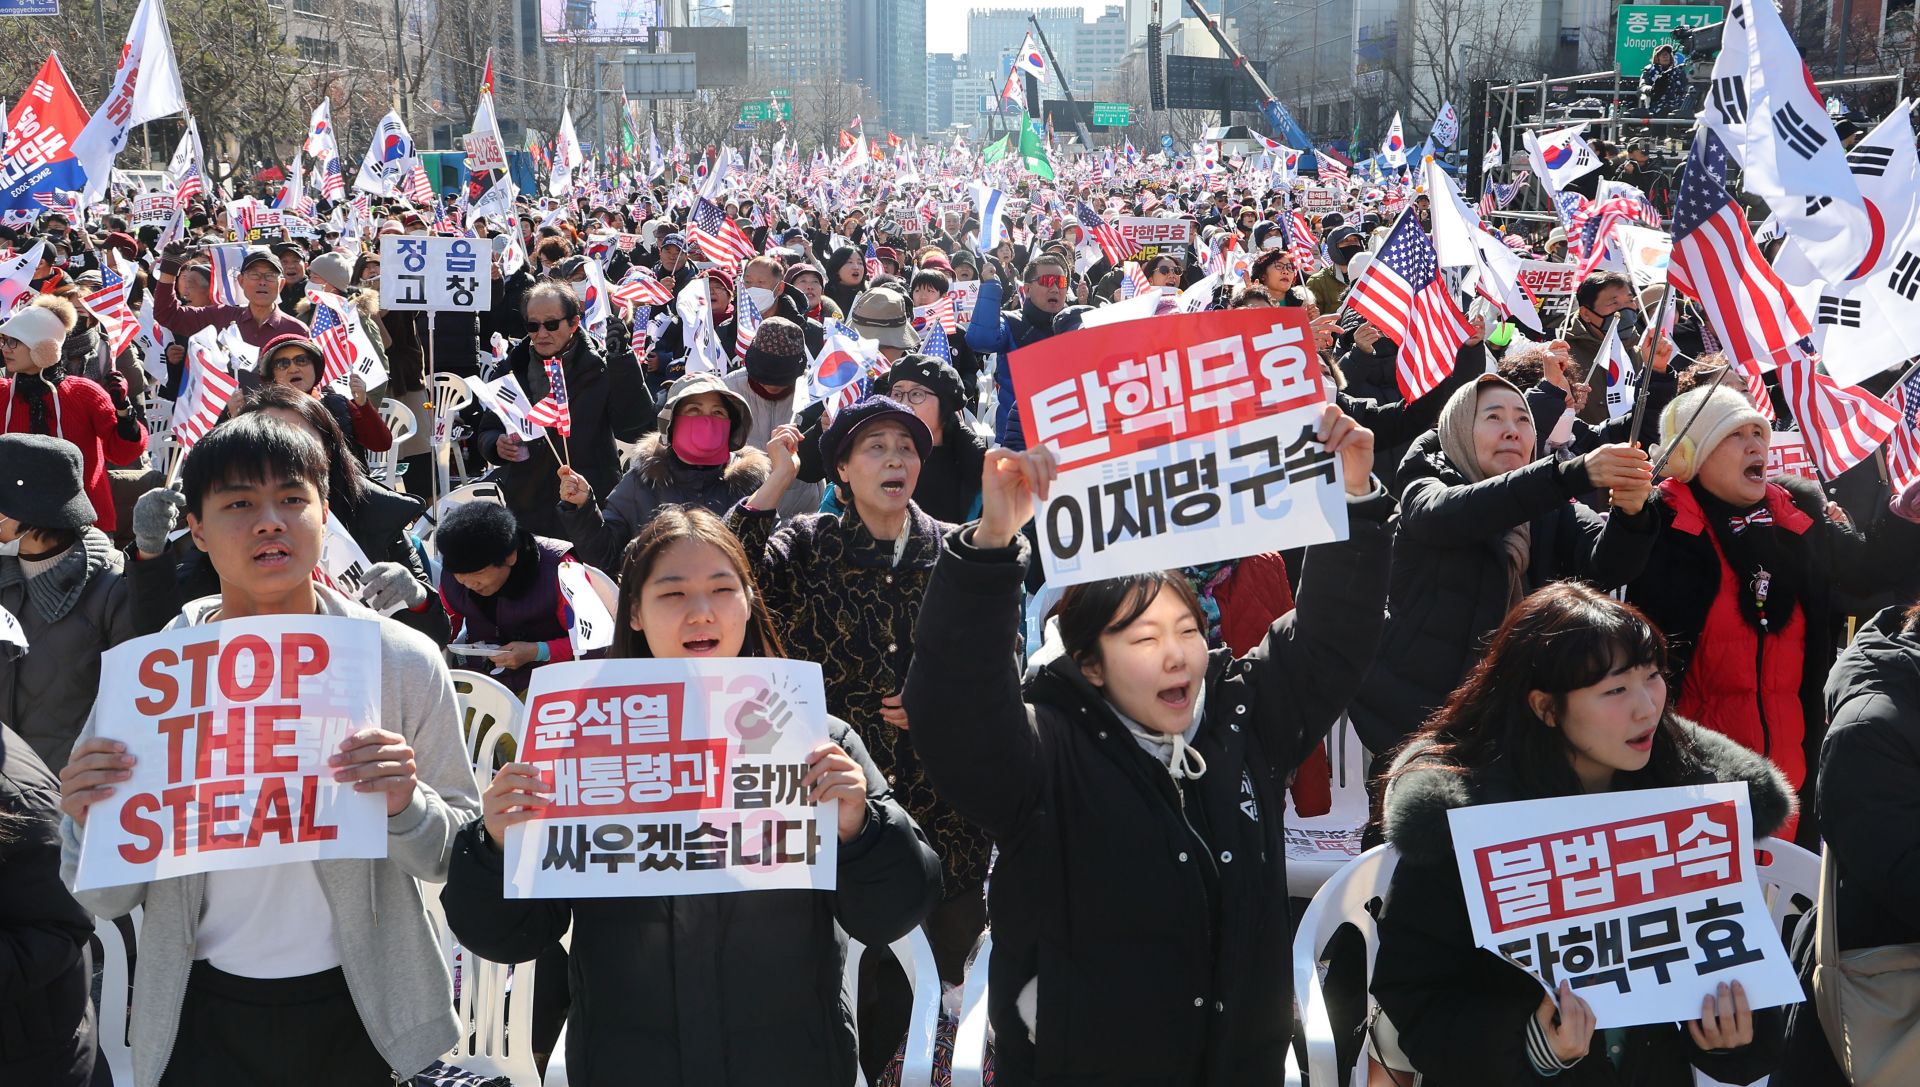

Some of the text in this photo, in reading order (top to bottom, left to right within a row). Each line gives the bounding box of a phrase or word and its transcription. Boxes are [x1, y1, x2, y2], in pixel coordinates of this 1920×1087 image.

[1624, 36, 1657, 50] Jongno
[1626, 12, 1711, 33] 종로1가
[133, 210, 172, 225] 탄핵무효
[1122, 224, 1186, 242] 탄핵무효
[1030, 323, 1316, 466] 탄핵무효
[1046, 424, 1337, 559] 이재명 구속
[135, 633, 330, 716] STOP
[157, 705, 301, 784] THE
[534, 694, 669, 750] 윤석열
[523, 750, 818, 809] 대통령과 함께
[117, 775, 338, 864] STEAL
[542, 819, 821, 873] 싸우겠습니다
[1488, 812, 1732, 925] 불법구속
